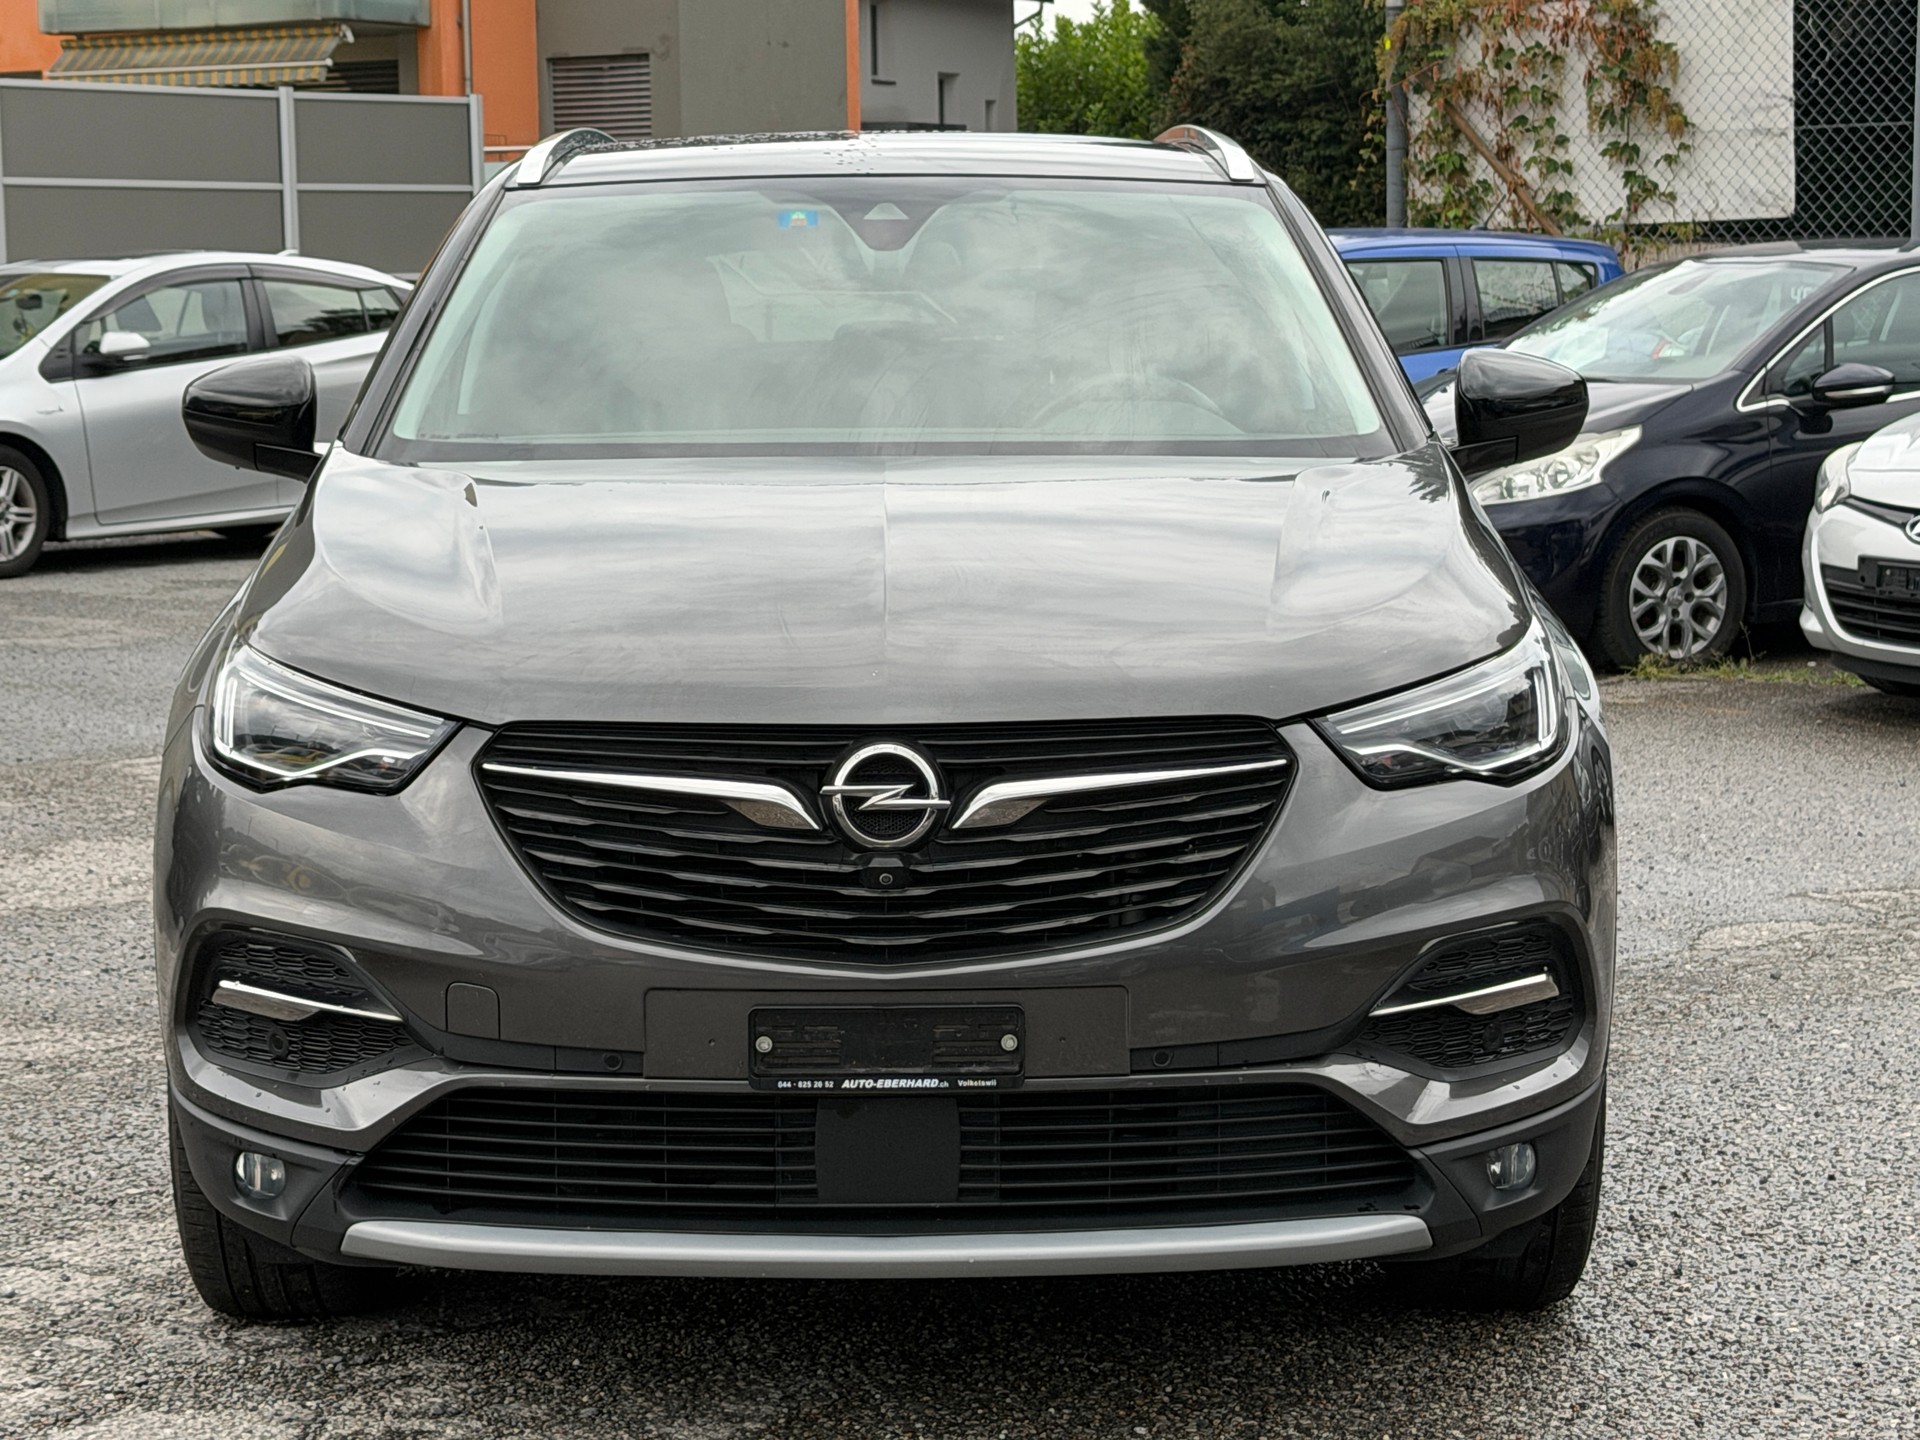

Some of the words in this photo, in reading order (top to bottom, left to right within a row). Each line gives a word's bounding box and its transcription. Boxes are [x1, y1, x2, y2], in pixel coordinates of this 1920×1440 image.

[777, 1080, 792, 1089] 044
[797, 1080, 812, 1089] 825
[813, 1080, 823, 1089] 20
[824, 1080, 834, 1089] 52
[841, 1078, 949, 1089] AUTO-EBERHARD.ch
